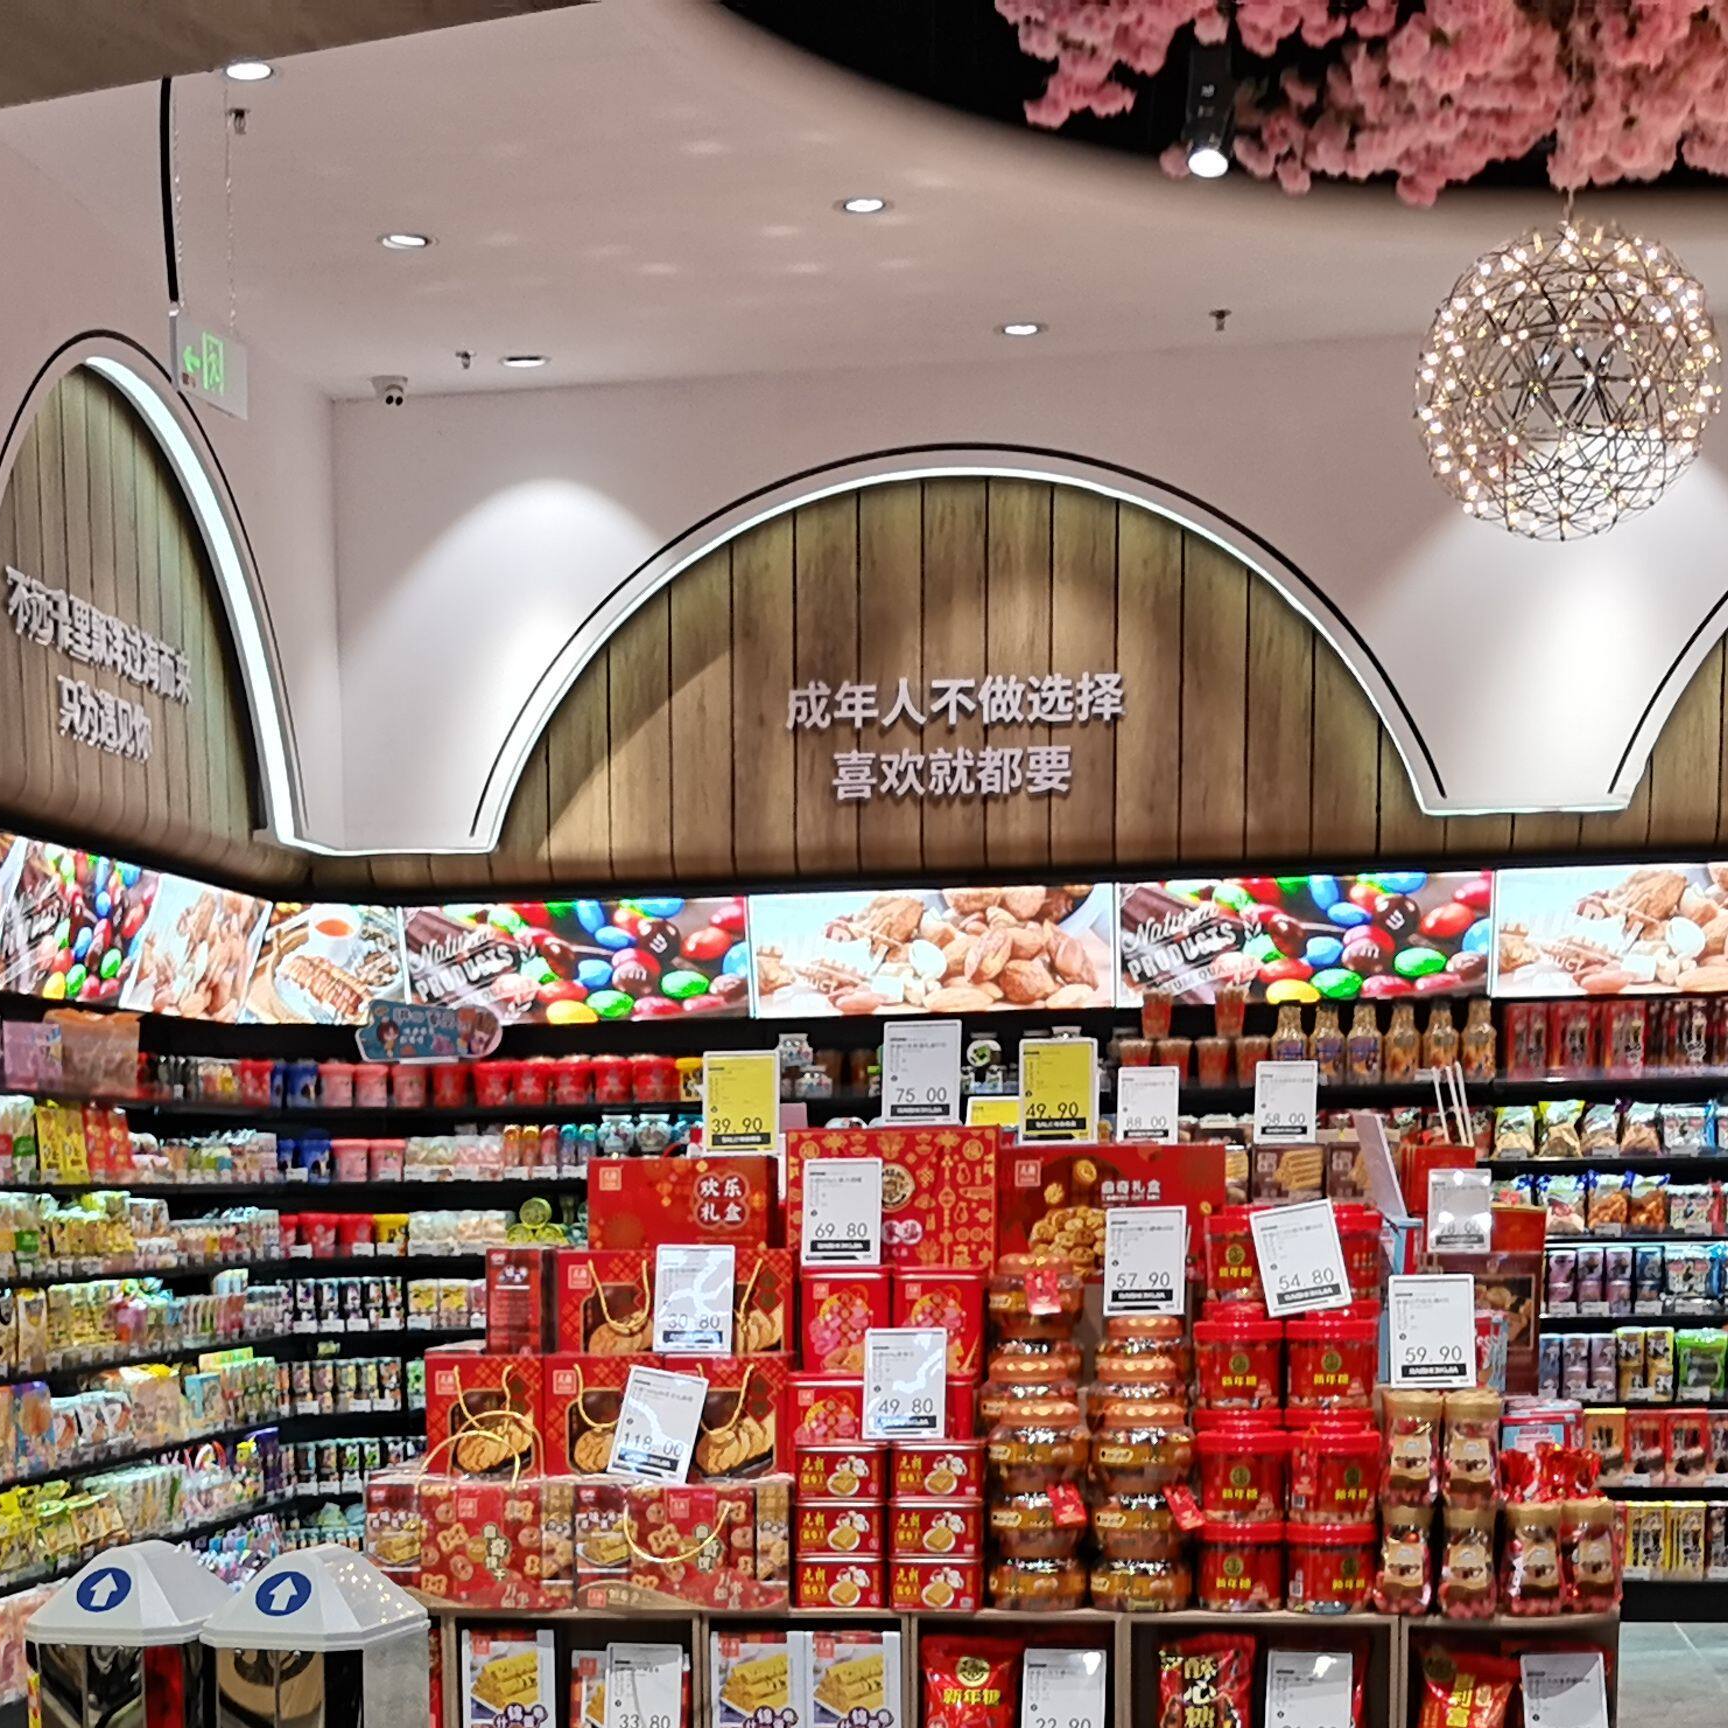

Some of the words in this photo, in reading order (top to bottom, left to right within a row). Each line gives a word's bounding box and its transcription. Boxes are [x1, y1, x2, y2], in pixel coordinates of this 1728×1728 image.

[785, 671, 1126, 731] 成年人不做选择
[831, 745, 1073, 801] 喜欢就都要
[1126, 922, 1238, 982] PRODUCTS
[699, 1173, 744, 1198] 欢乐
[699, 1201, 743, 1224] 礼盒
[1116, 1272, 1171, 1290] 57.90
[1405, 1345, 1462, 1364] 59.90
[943, 1688, 1001, 1706] 新年糖
[1183, 1655, 1218, 1728] 酥心糖
